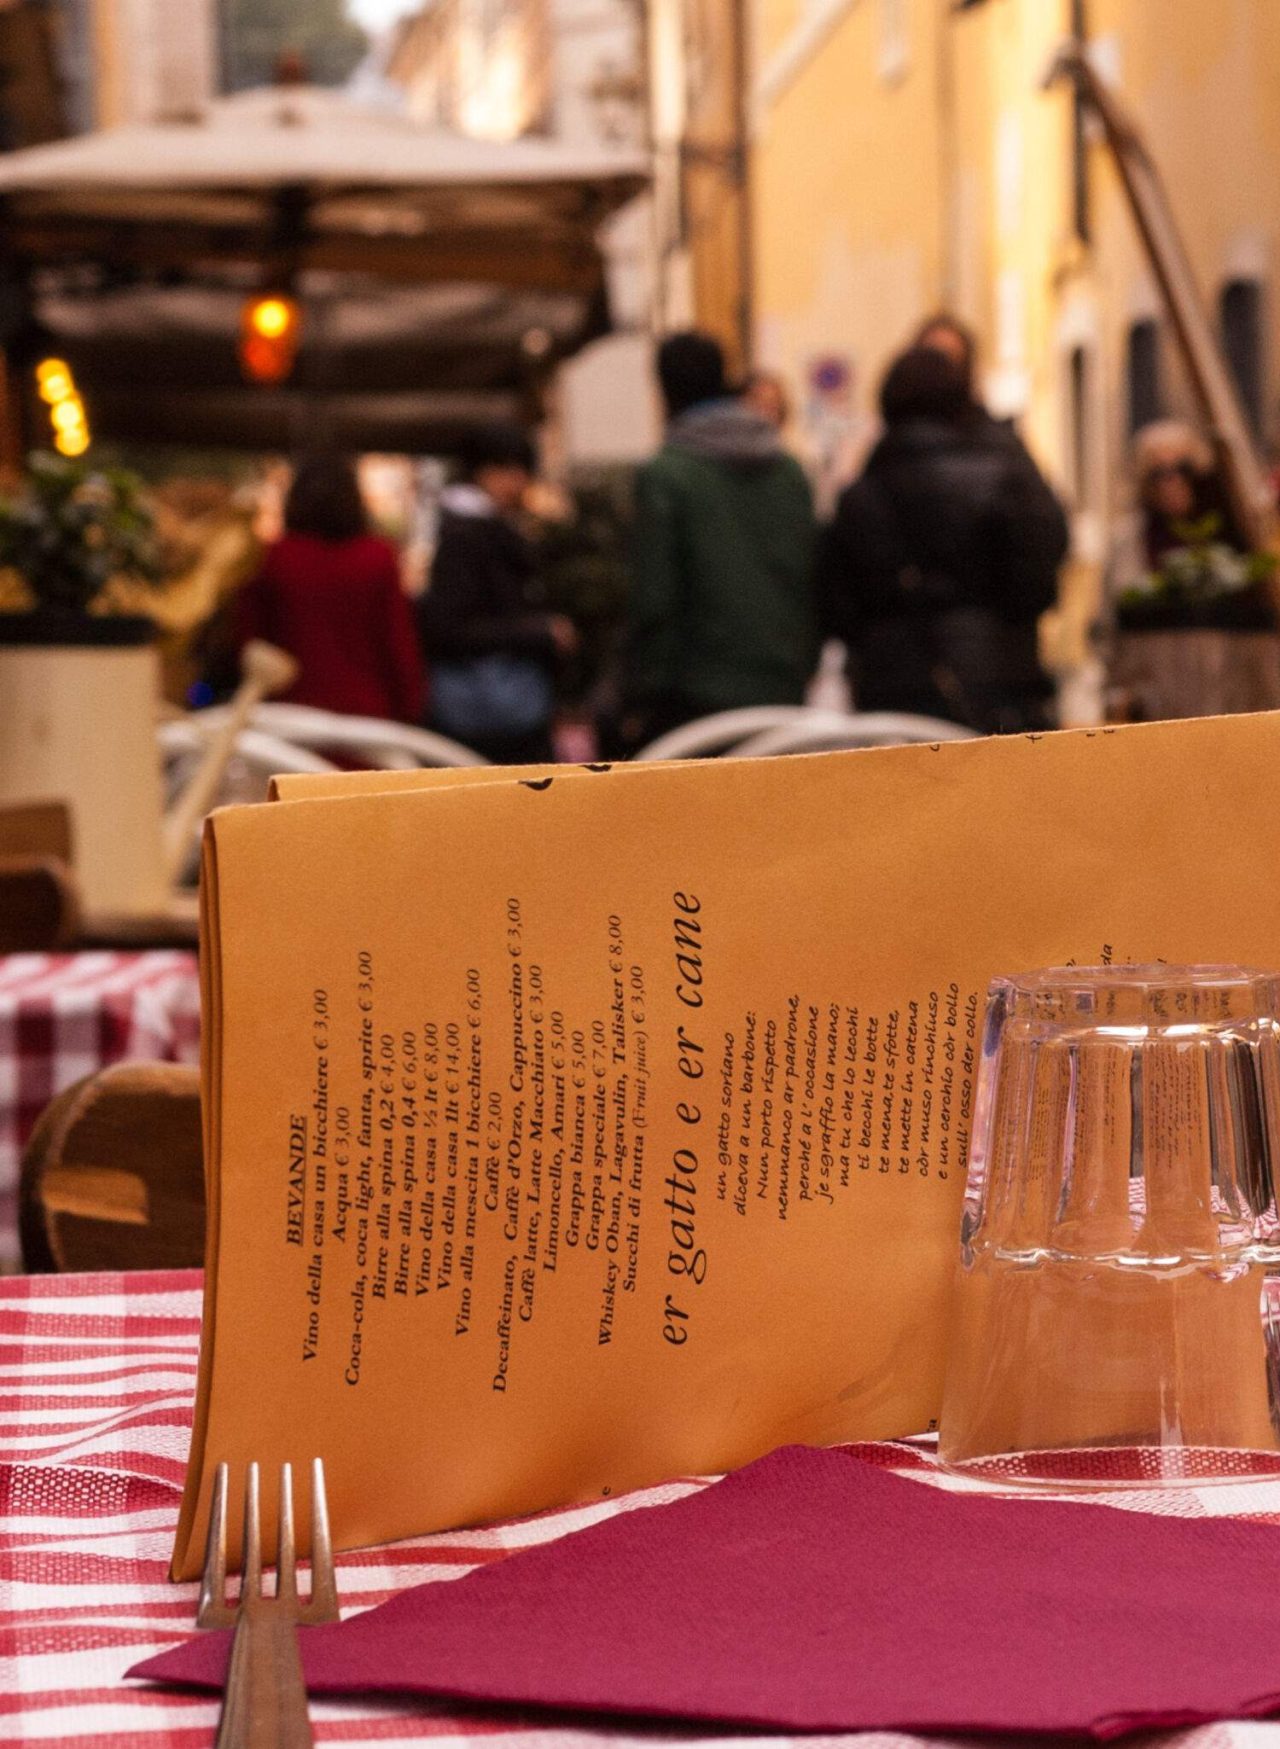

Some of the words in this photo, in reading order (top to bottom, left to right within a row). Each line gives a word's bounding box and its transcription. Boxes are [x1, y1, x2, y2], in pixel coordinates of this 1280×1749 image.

[507, 898, 523, 938] 3,00
[608, 914, 624, 956] 8,00
[358, 951, 375, 992] 3,00
[508, 943, 522, 958] €
[609, 960, 623, 974] €
[673, 891, 703, 1008] cane
[358, 998, 373, 1013] €
[466, 968, 482, 1011] 6,00
[529, 964, 544, 1003] 3,00
[630, 965, 646, 1005] 3,00
[943, 983, 959, 1028] bollo
[313, 989, 330, 1029] 3,00
[467, 1015, 481, 1029] €
[509, 963, 528, 1093] Cappuccino
[529, 1010, 544, 1024] €
[550, 1011, 566, 1051] 5,00
[611, 978, 626, 1064] Talisker
[631, 1010, 645, 1024] €
[906, 1000, 919, 1065] catena
[964, 992, 978, 1038] collo.
[313, 1036, 329, 1051] €
[358, 1018, 377, 1080] sprite
[380, 1034, 396, 1077] 4,00
[402, 1031, 418, 1074] 6,00
[424, 1022, 440, 1065] 8,00
[445, 1022, 461, 1074] 14,00
[571, 1030, 587, 1069] 5,00
[591, 1020, 607, 1059] 7,00
[677, 1025, 704, 1079] er
[739, 1011, 756, 1094] barbone:
[761, 1019, 779, 1093] rispetto
[783, 994, 800, 1078] padrone,
[804, 1006, 819, 1100] occasione
[827, 1002, 840, 1066] mano;
[844, 1007, 859, 1062] lecchi
[863, 1017, 879, 1063] botte
[883, 1010, 900, 1069] sfotte,
[921, 991, 939, 1084] rinchiuso
[942, 1032, 955, 1062] còr
[424, 1069, 438, 1083] €
[551, 1056, 565, 1070] €
[592, 1064, 606, 1079] €
[720, 1032, 735, 1108] soriano
[822, 1071, 835, 1091] la
[842, 1067, 856, 1086] lo
[863, 1068, 876, 1085] le
[900, 1070, 914, 1093] in
[963, 1043, 975, 1073] der
[380, 1081, 394, 1095] €
[402, 1077, 416, 1092] €
[424, 1087, 438, 1104] lt
[445, 1081, 459, 1095] €
[466, 1034, 482, 1133] bicchiere
[529, 1029, 544, 1143] Macchiato
[572, 1075, 585, 1089] €
[783, 1081, 794, 1104] ar
[940, 1066, 954, 1132] cerchio
[961, 1080, 972, 1119] osso
[312, 1056, 328, 1157] bicchiere
[334, 1106, 353, 1147] 3,00
[357, 1087, 375, 1148] fanta,
[379, 1098, 397, 1132] 0,2
[401, 1096, 419, 1128] 0,4
[444, 1100, 459, 1124] 1lt
[487, 1091, 503, 1133] 2,00
[550, 1074, 565, 1141] Amari
[569, 1095, 586, 1164] bianca
[592, 1083, 608, 1168] speciale
[609, 1073, 629, 1183] Lagavulin,
[676, 1102, 701, 1125] e
[742, 1099, 752, 1129] un
[760, 1099, 775, 1148] porto
[801, 1123, 812, 1136] a
[841, 1090, 854, 1122] che
[858, 1090, 874, 1149] becchi
[900, 1097, 913, 1152] mette
[920, 1089, 932, 1143] muso
[335, 1153, 349, 1167] €
[447, 1131, 458, 1178] casa
[465, 1139, 479, 1148] 1
[487, 1137, 501, 1151] €
[717, 1112, 732, 1166] gatto
[739, 1135, 750, 1148] a
[818, 1096, 836, 1178] sgraffio
[839, 1128, 852, 1149] tu
[939, 1136, 949, 1165] un
[286, 1114, 307, 1247] BEVANDE
[315, 1164, 327, 1193] un
[355, 1156, 375, 1212] light,
[378, 1138, 397, 1197] spina
[400, 1135, 419, 1193] spina
[426, 1137, 437, 1185] casa
[484, 1156, 500, 1212] Caffè
[526, 1149, 542, 1204] Latte
[629, 1135, 644, 1191] frutta
[733, 1153, 749, 1216] diceva
[756, 1152, 769, 1199] Nun
[778, 1109, 793, 1221] nemmanco
[798, 1139, 813, 1201] perché
[839, 1155, 850, 1187] ma
[857, 1154, 870, 1170] ti
[878, 1156, 890, 1174] te
[898, 1156, 910, 1174] te
[916, 1146, 929, 1177] còr
[938, 1170, 948, 1180] e
[331, 1173, 352, 1243] Acqua
[464, 1156, 479, 1239] mescita
[565, 1171, 586, 1248] Grappa
[628, 1197, 641, 1218] di
[717, 1171, 727, 1201] un
[814, 1182, 834, 1205] je
[313, 1200, 325, 1248] casa
[376, 1203, 391, 1240] alla
[398, 1199, 413, 1237] alla
[419, 1191, 435, 1242] della
[440, 1185, 456, 1236] della
[504, 1185, 520, 1242] Caffè
[542, 1148, 566, 1273] Limoncello,
[585, 1175, 606, 1251] Grappa
[605, 1191, 624, 1254] Oban,
[663, 1149, 707, 1285] gatto
[356, 1218, 368, 1268] coca
[523, 1211, 542, 1263] latte,
[623, 1223, 640, 1292] Succhi
[306, 1254, 323, 1306] della
[372, 1246, 389, 1300] Birre
[393, 1243, 411, 1296] Birre
[415, 1247, 431, 1297] Vino
[437, 1241, 453, 1290] Vino
[459, 1245, 475, 1281] alla
[455, 1287, 471, 1336] Vino
[518, 1268, 535, 1322] Caffè
[598, 1259, 621, 1346] Whiskey
[302, 1311, 319, 1361] Vino
[344, 1274, 369, 1386] Coca-cola,
[492, 1255, 518, 1393] Decaffeinato,
[663, 1294, 689, 1345] er
